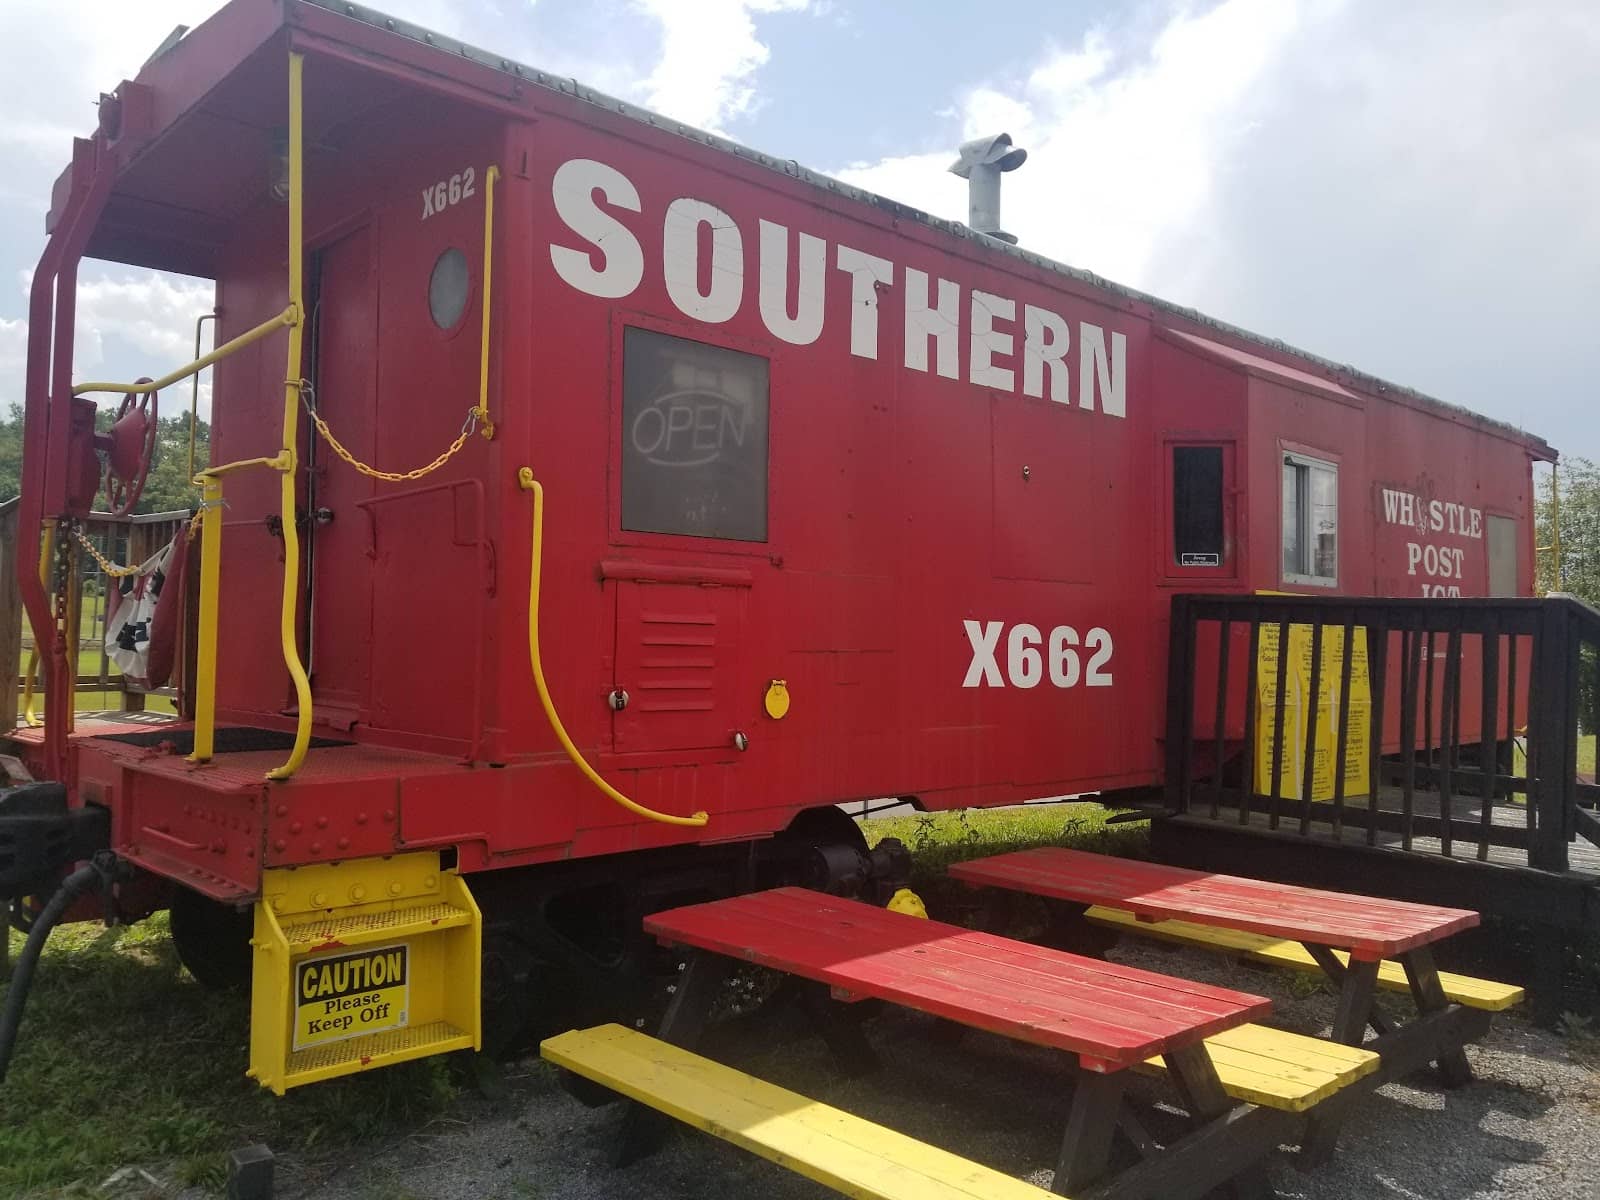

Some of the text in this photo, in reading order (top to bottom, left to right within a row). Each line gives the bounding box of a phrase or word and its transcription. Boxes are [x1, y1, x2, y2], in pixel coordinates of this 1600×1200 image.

[422, 167, 475, 220] X662
[549, 158, 1127, 419] SOUTHERN
[632, 404, 747, 454] OPEN
[1407, 542, 1465, 579] POST
[962, 619, 1113, 689] X662
[302, 951, 402, 999] CAUTION
[307, 1015, 353, 1035] Keep
[360, 1003, 390, 1023] Off
[324, 993, 381, 1015] Please
